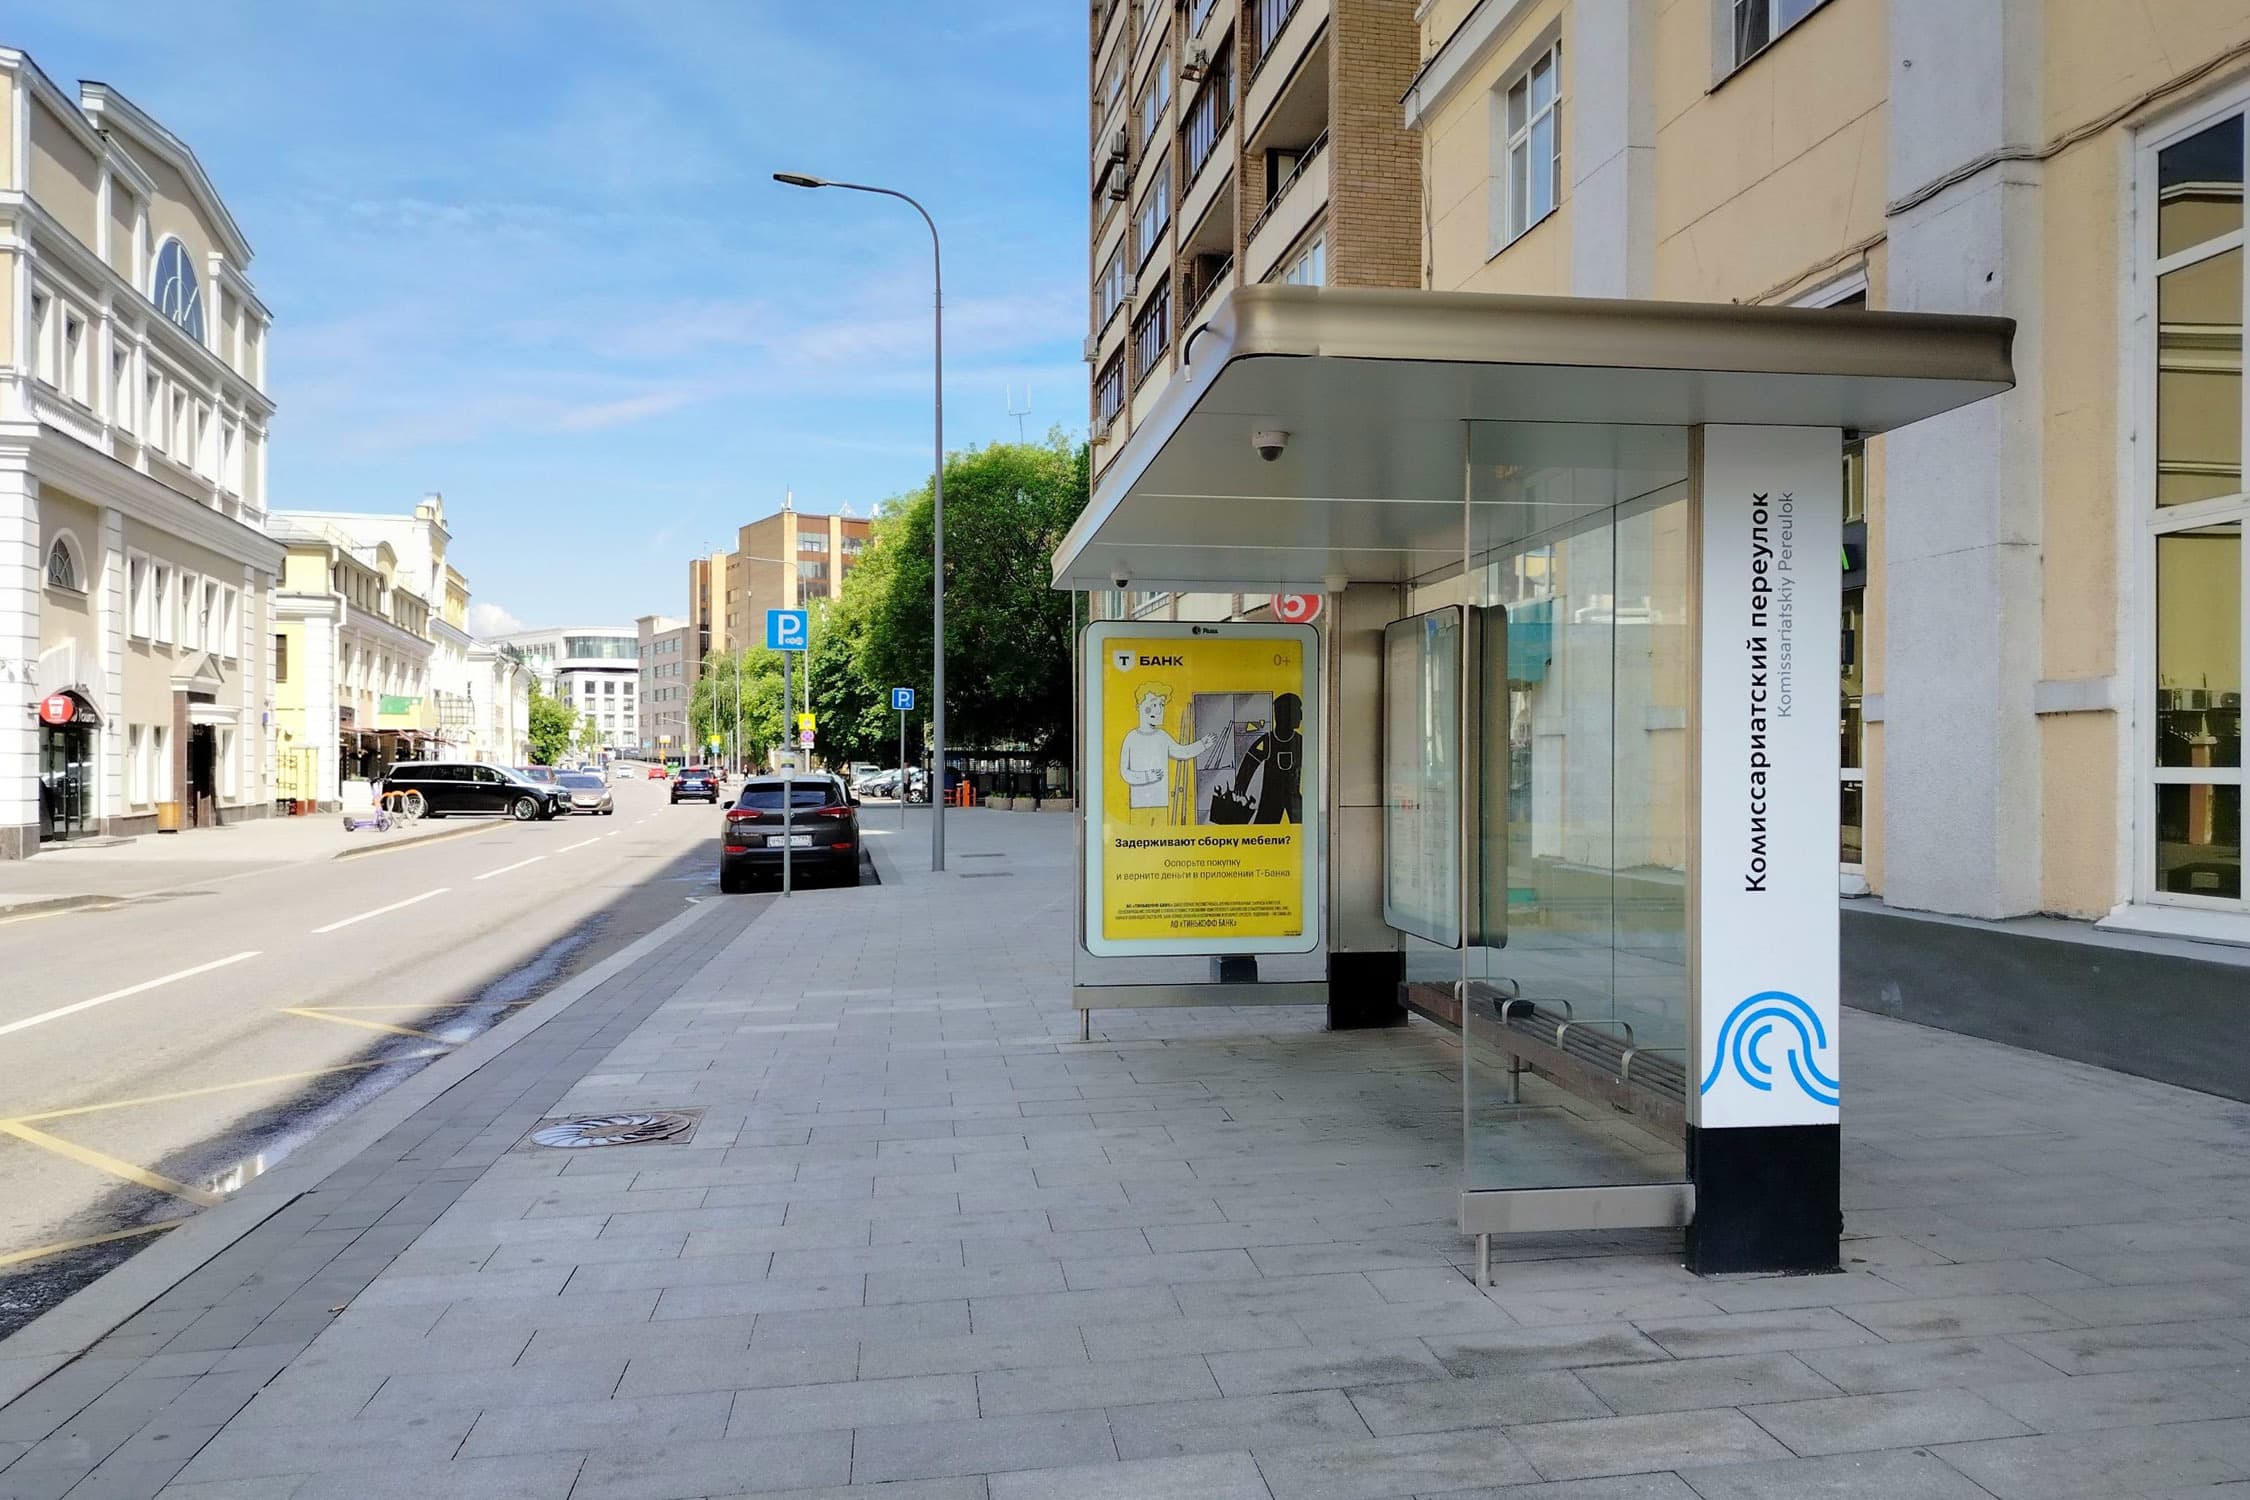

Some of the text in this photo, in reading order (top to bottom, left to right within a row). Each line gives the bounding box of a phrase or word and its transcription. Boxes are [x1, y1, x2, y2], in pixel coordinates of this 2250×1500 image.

[1777, 492, 1796, 717] Komissariatskiy Pereulok
[778, 614, 800, 645] P
[1139, 656, 1184, 666] БАНК
[1273, 654, 1291, 667] 0+
[898, 691, 910, 707] P
[1745, 492, 1773, 892] Комиссариатский переулок
[1115, 835, 1291, 849] Задерживают сборку мебели?
[1164, 859, 1241, 868] Оспорьте покупку
[1124, 873, 1159, 882] верните
[1161, 873, 1191, 881] деньги
[1200, 871, 1254, 880] приложении
[1255, 869, 1290, 878] Т-Банка
